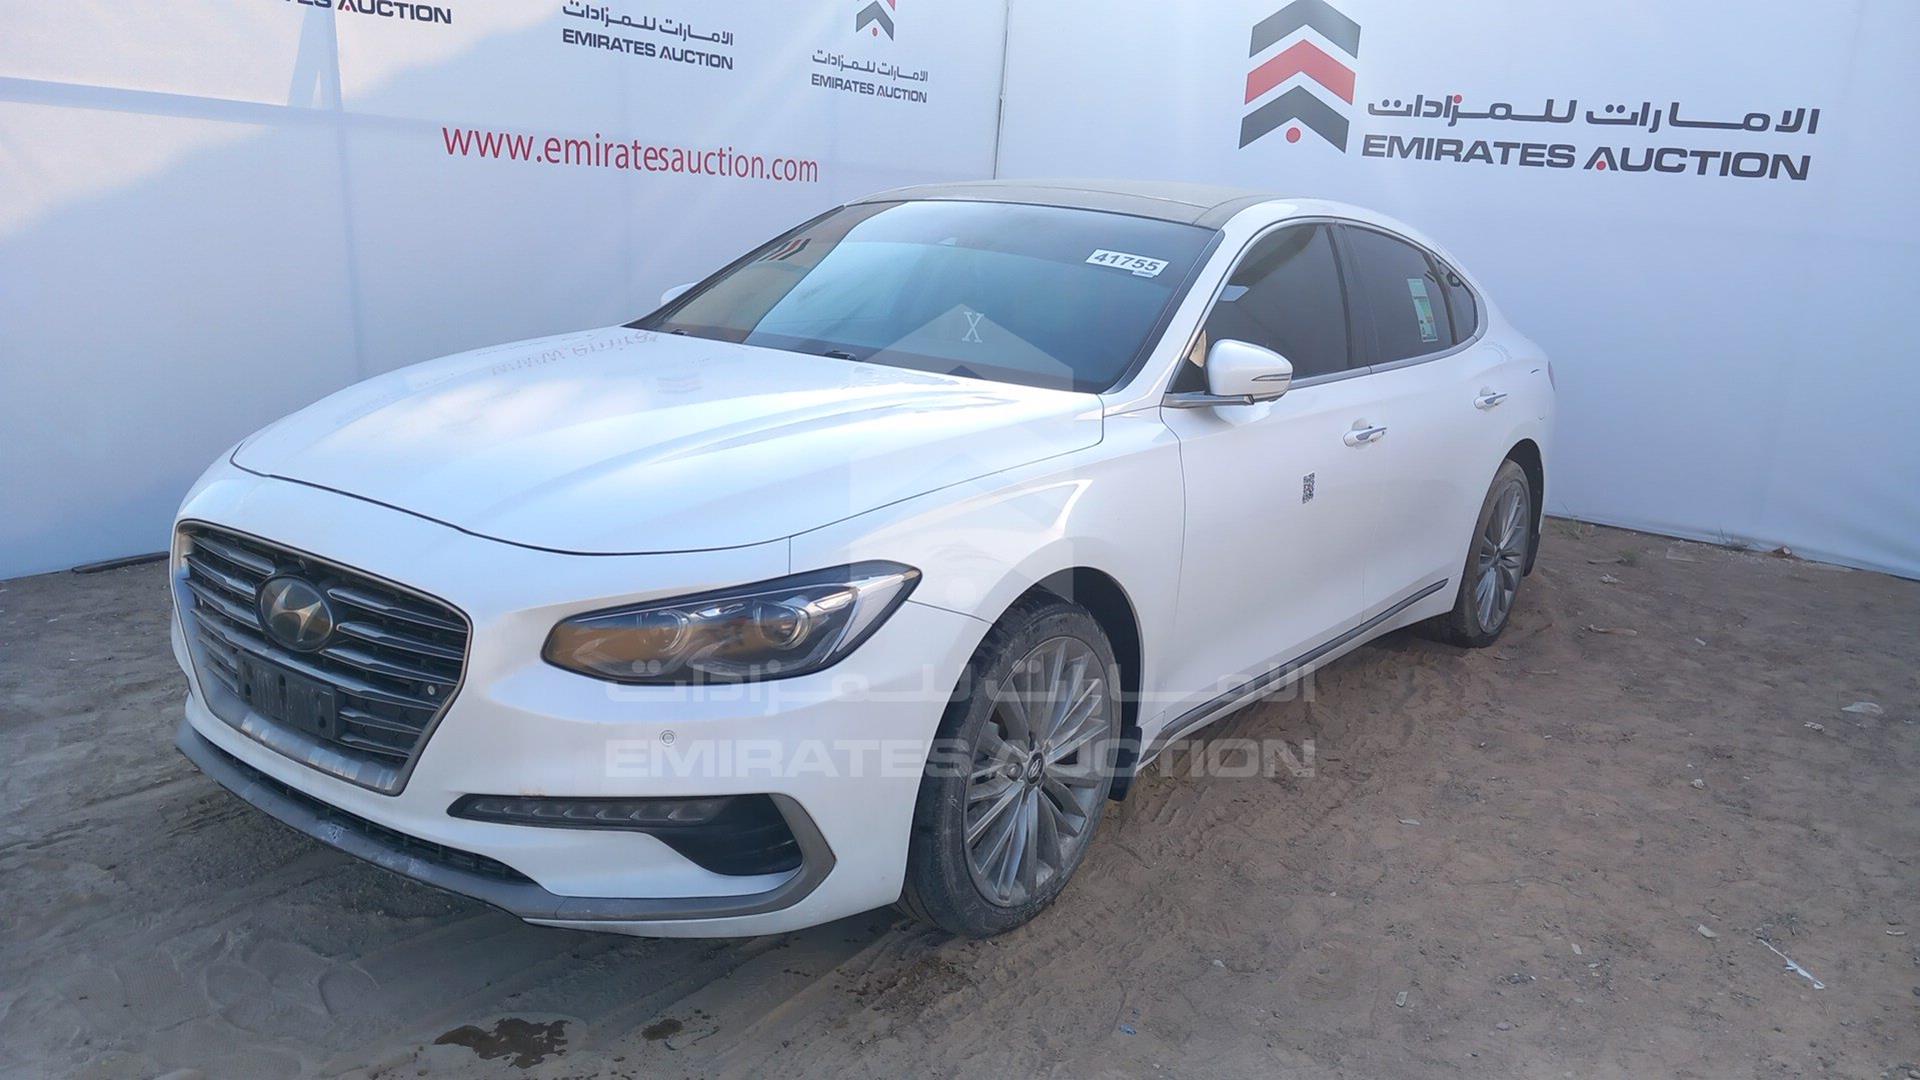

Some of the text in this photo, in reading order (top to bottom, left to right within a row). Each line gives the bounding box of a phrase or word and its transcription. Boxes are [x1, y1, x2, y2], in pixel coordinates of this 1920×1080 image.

[337, 0, 452, 24] AUCTION
[562, 28, 733, 70] EMIRATES AUCTION
[811, 73, 927, 103] EMIRATES AUCTION
[442, 127, 818, 182] www.emiratesauction.com
[1362, 134, 1810, 181] EMIRATES AUCTION
[1094, 252, 1160, 271] 41755
